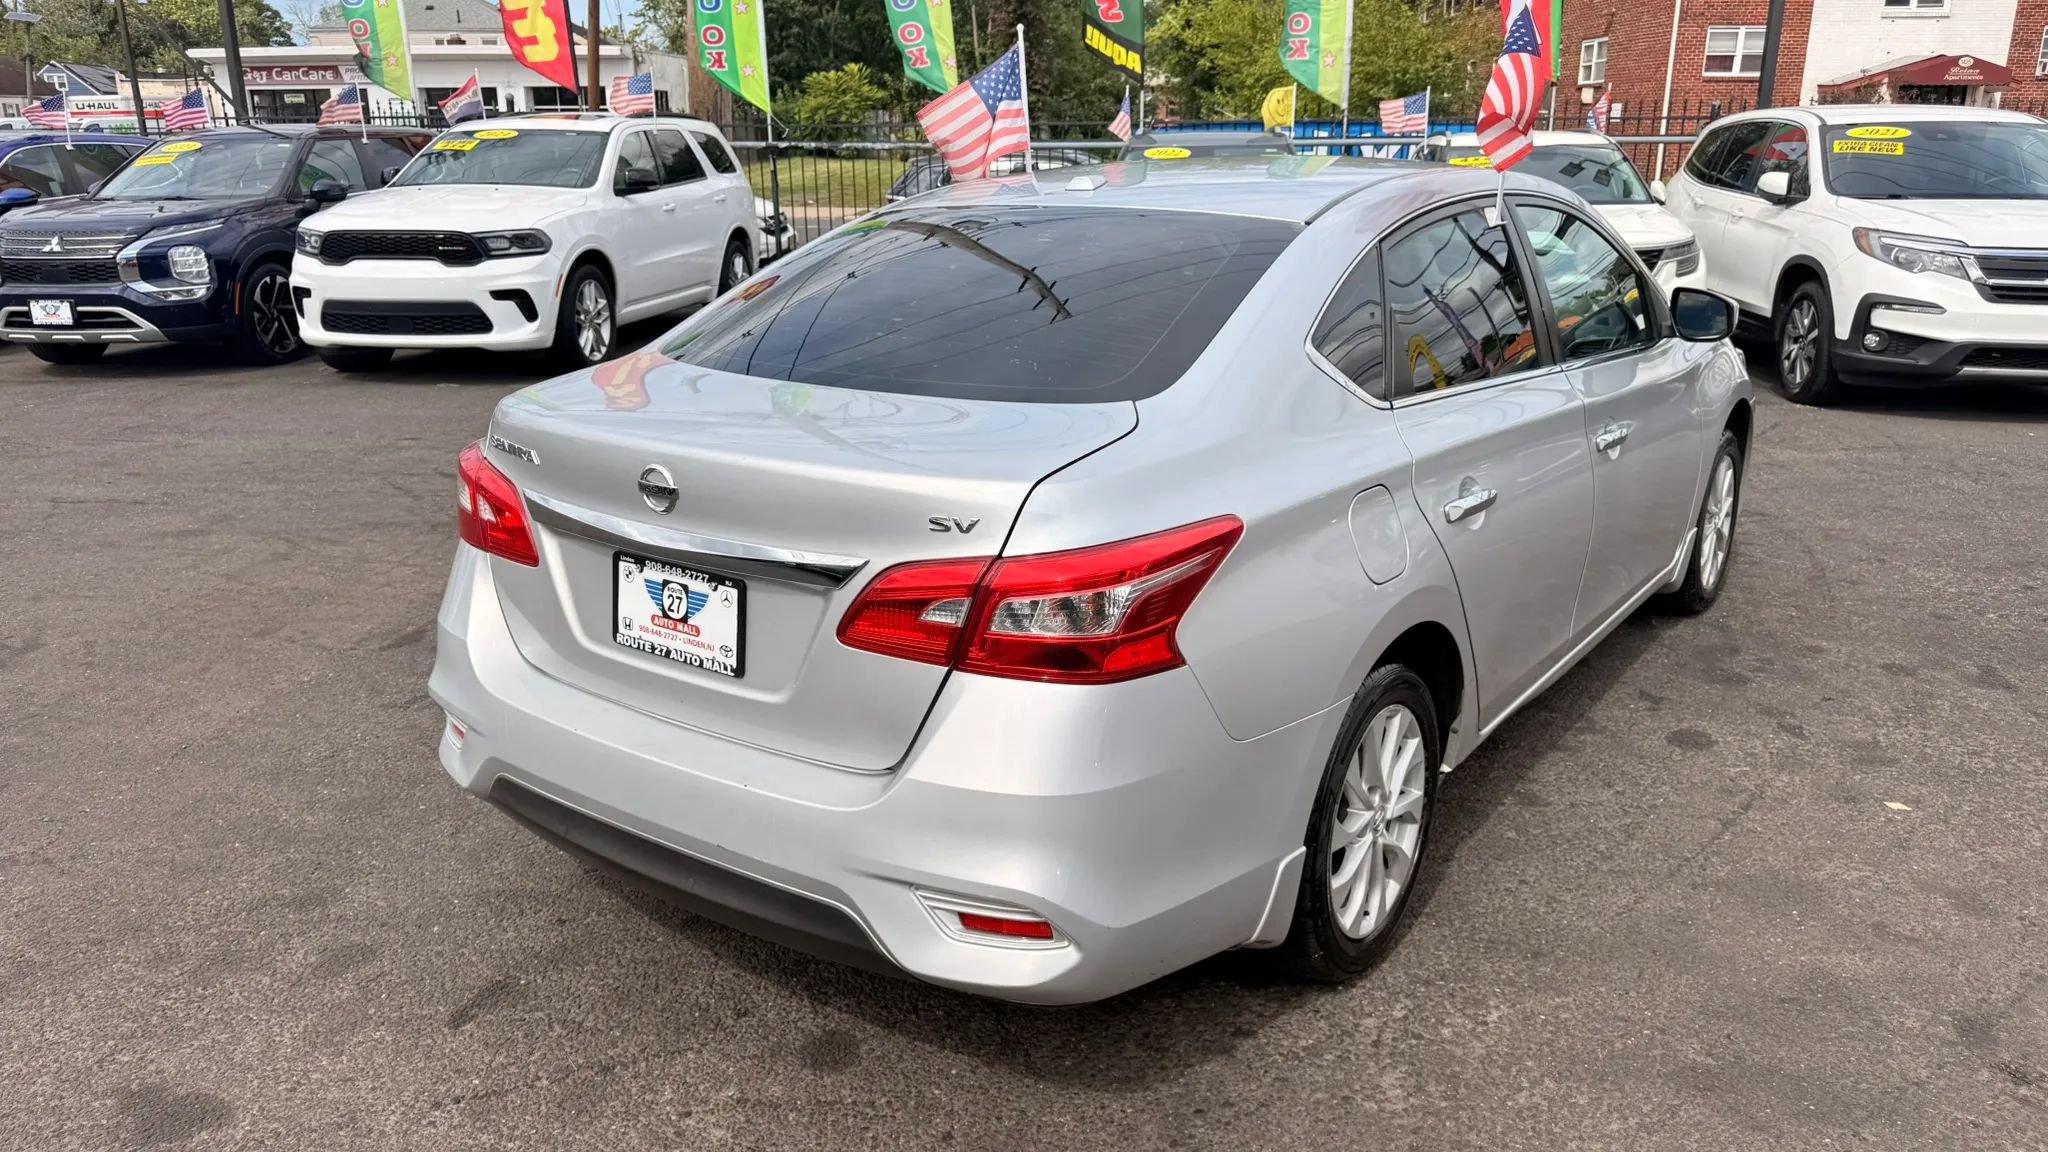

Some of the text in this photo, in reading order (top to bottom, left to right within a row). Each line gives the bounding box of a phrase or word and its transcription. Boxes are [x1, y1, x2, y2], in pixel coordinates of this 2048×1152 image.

[272, 66, 335, 81] CarCare
[1858, 128, 1899, 136] 2021
[928, 516, 981, 534] SV
[645, 560, 709, 584] 908-648-2727
[667, 594, 683, 614] 27
[654, 615, 698, 635] AUTO MALL
[616, 632, 735, 676] ROUTE 27 AUTO MALL
